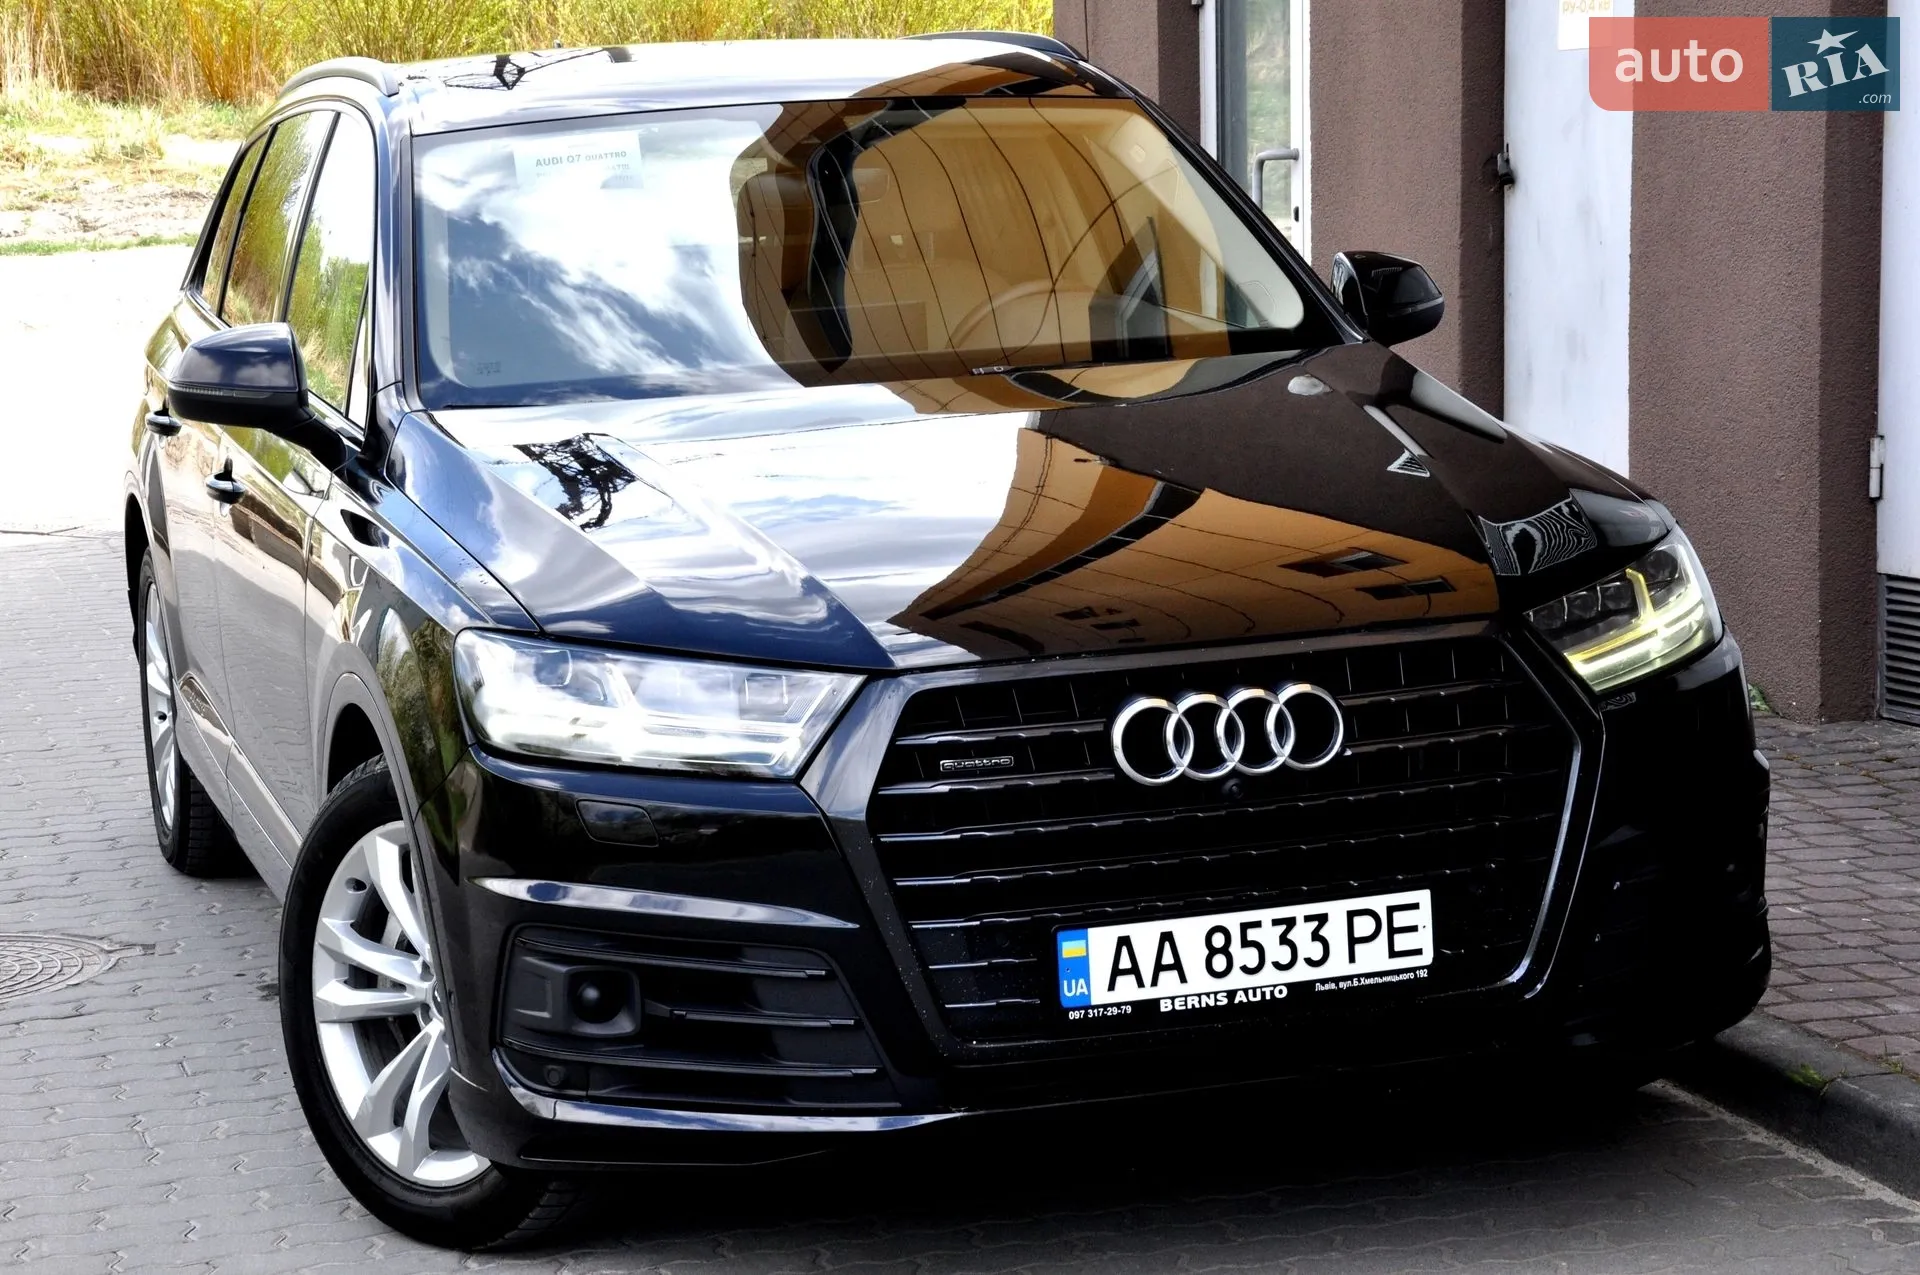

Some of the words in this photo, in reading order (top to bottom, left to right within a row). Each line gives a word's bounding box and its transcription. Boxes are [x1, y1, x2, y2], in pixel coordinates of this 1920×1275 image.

[535, 156, 563, 167] AUDI
[566, 154, 581, 164] Q7
[585, 151, 627, 161] QUATTRO
[943, 758, 1011, 770] quattro
[1107, 930, 1188, 992] AA
[1204, 912, 1330, 979] 8533
[1346, 902, 1424, 964] PE
[1063, 979, 1088, 996] UA
[1315, 982, 1338, 992] Львів,
[1415, 968, 1428, 978] 192
[1159, 992, 1228, 1012] BERNS
[1234, 985, 1288, 1004] AUTO
[1068, 1010, 1085, 1020] 097
[1087, 1005, 1132, 1017] 317-29-79
